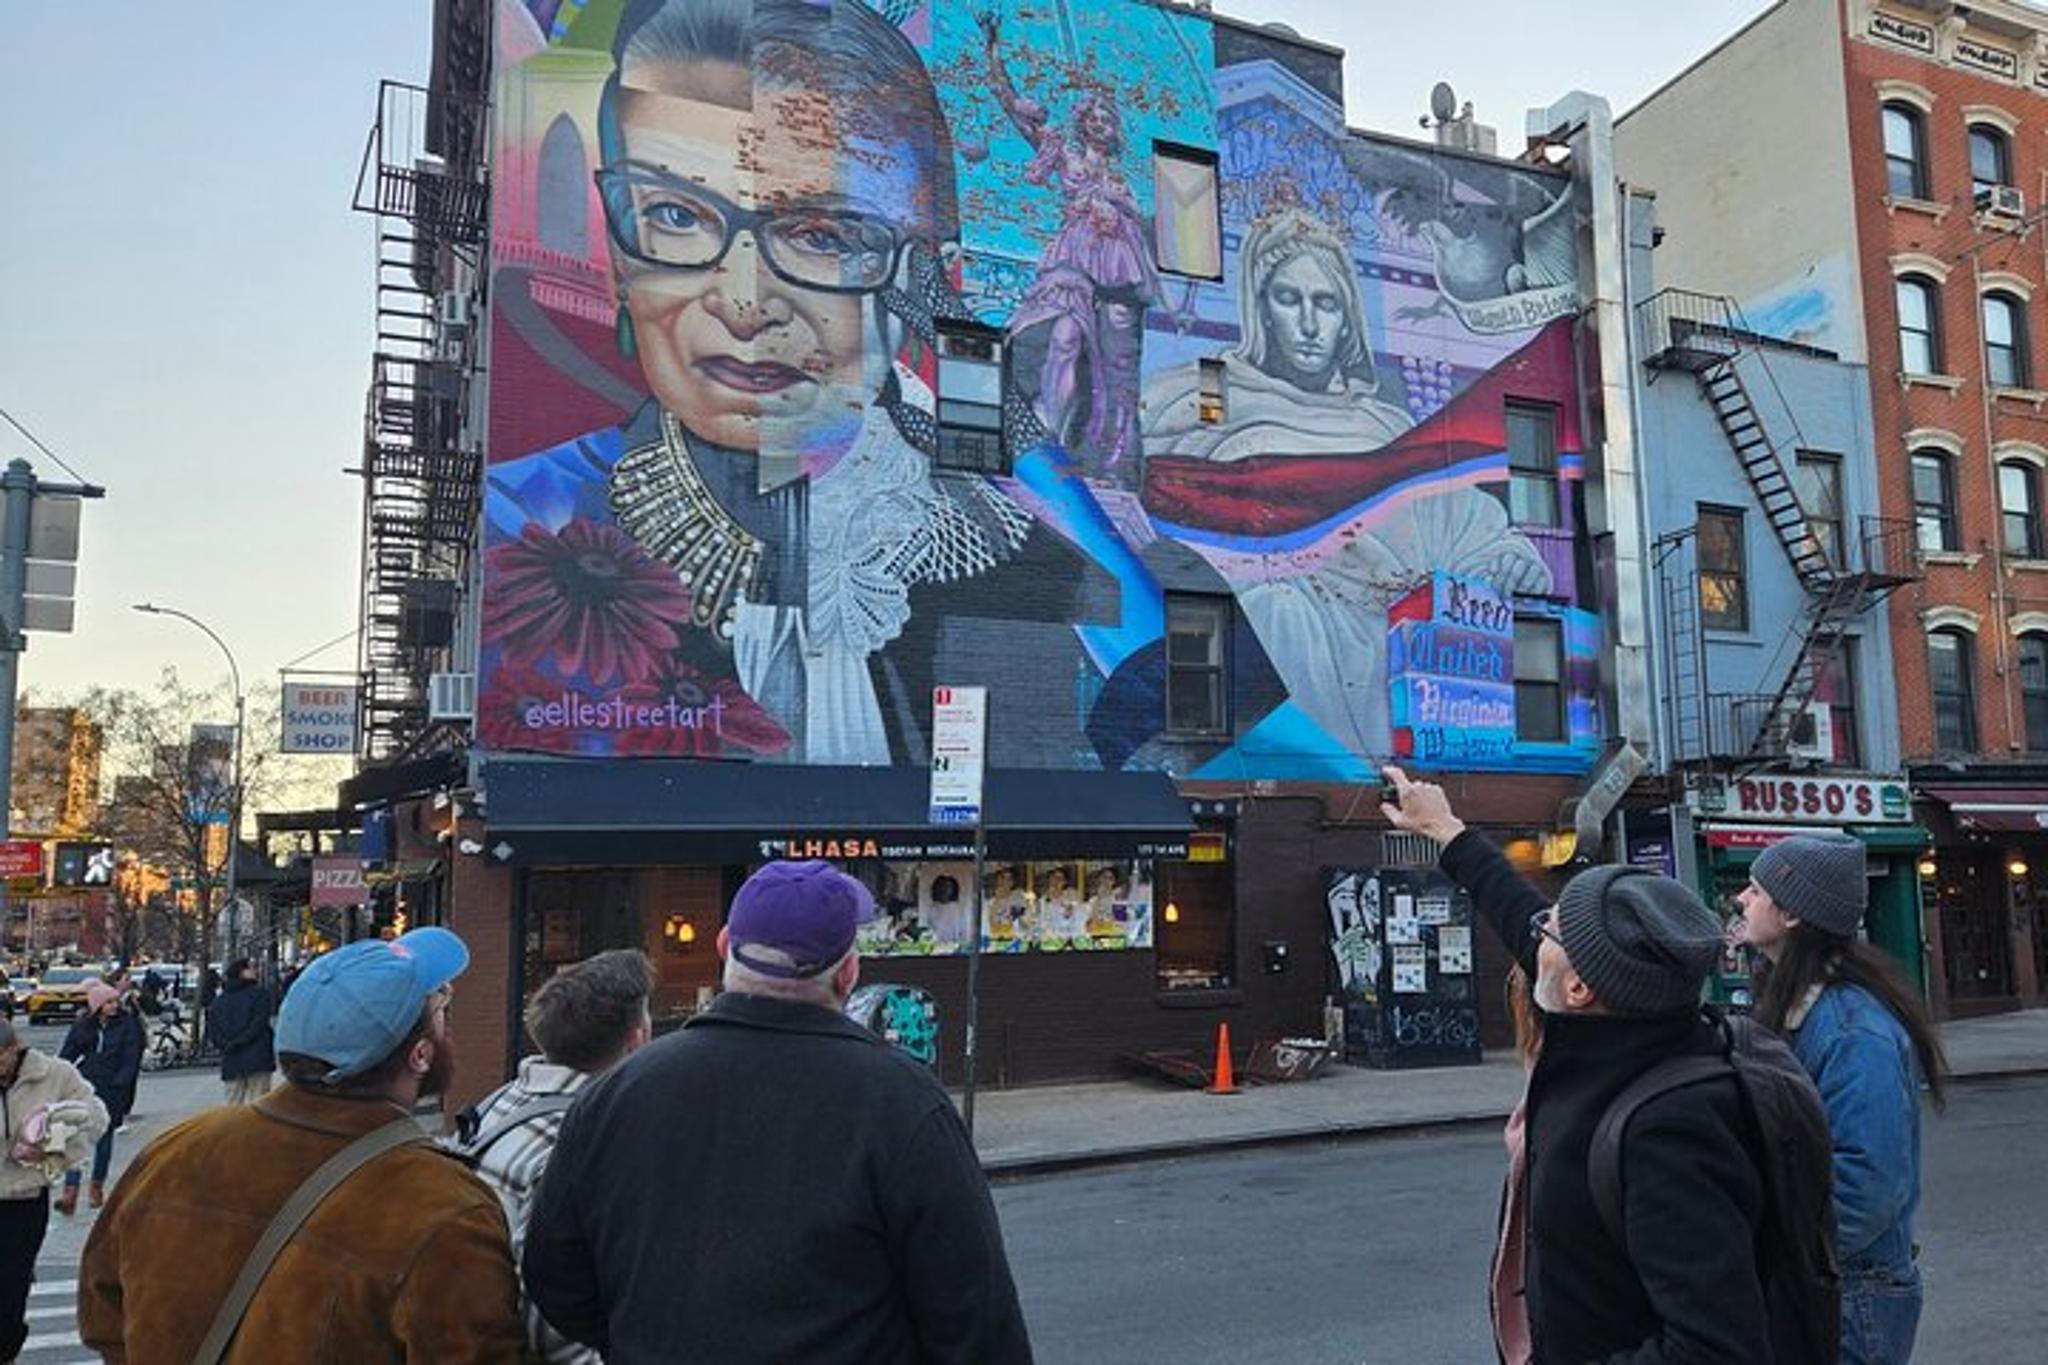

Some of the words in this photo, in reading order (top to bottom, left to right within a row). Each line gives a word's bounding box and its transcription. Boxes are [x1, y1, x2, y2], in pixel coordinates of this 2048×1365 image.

[297, 690, 348, 706] BEER
[525, 692, 726, 736] @ellestreetart
[294, 733, 350, 748] SHOP
[1738, 780, 1874, 816] RUSSO'S
[789, 841, 878, 857] LHASA
